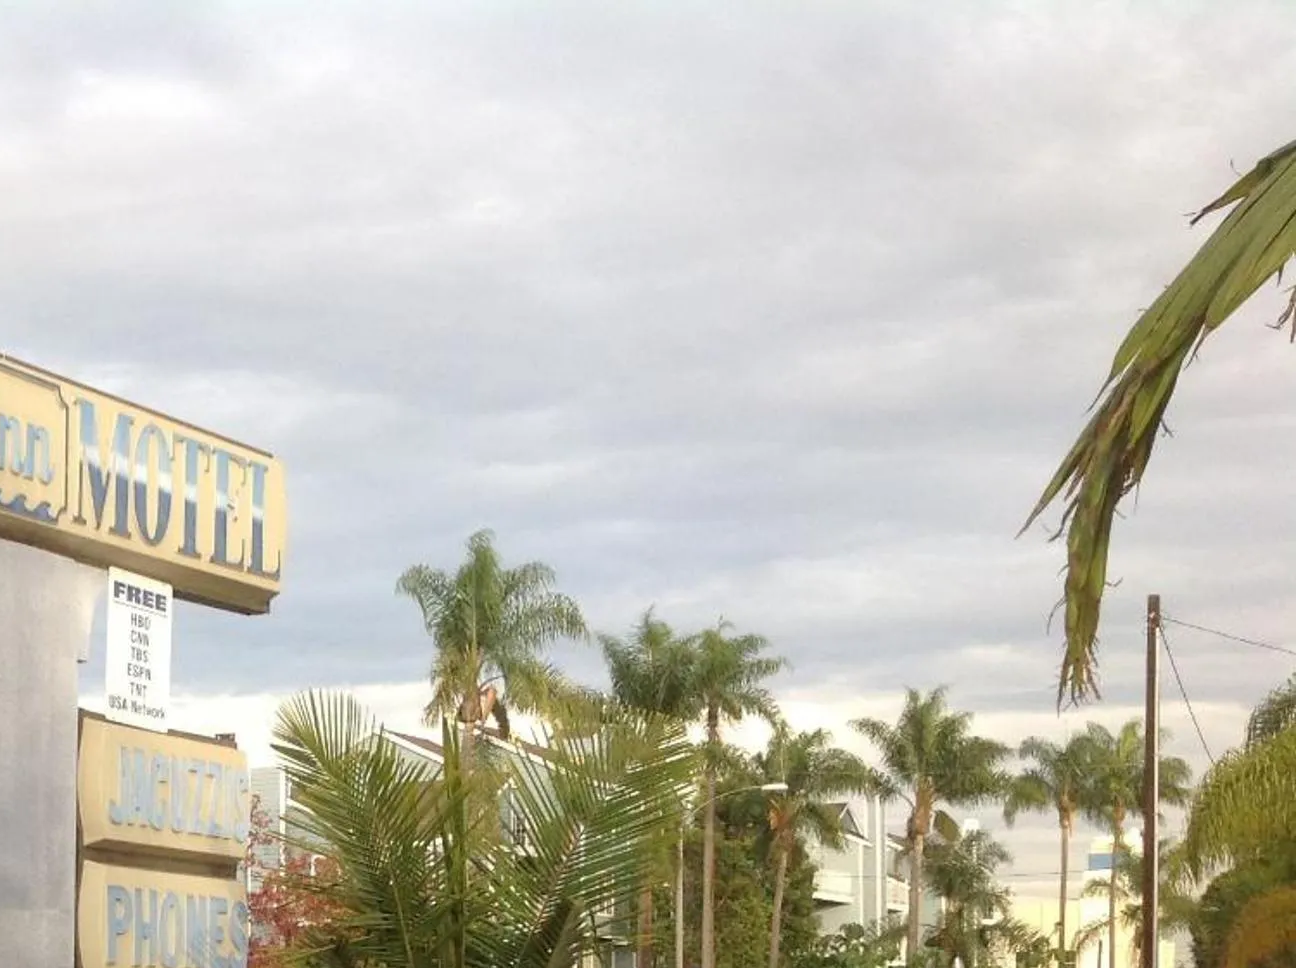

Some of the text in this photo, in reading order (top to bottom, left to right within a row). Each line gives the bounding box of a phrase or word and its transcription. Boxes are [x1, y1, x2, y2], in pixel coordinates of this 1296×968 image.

[72, 397, 282, 580] MOTEL
[112, 580, 168, 612] FREE
[130, 613, 151, 631] HBO
[130, 629, 150, 647] CNN
[130, 646, 149, 663] TBS
[127, 662, 152, 681] ESPN
[129, 682, 147, 698] TNT
[108, 694, 166, 720] USA Network
